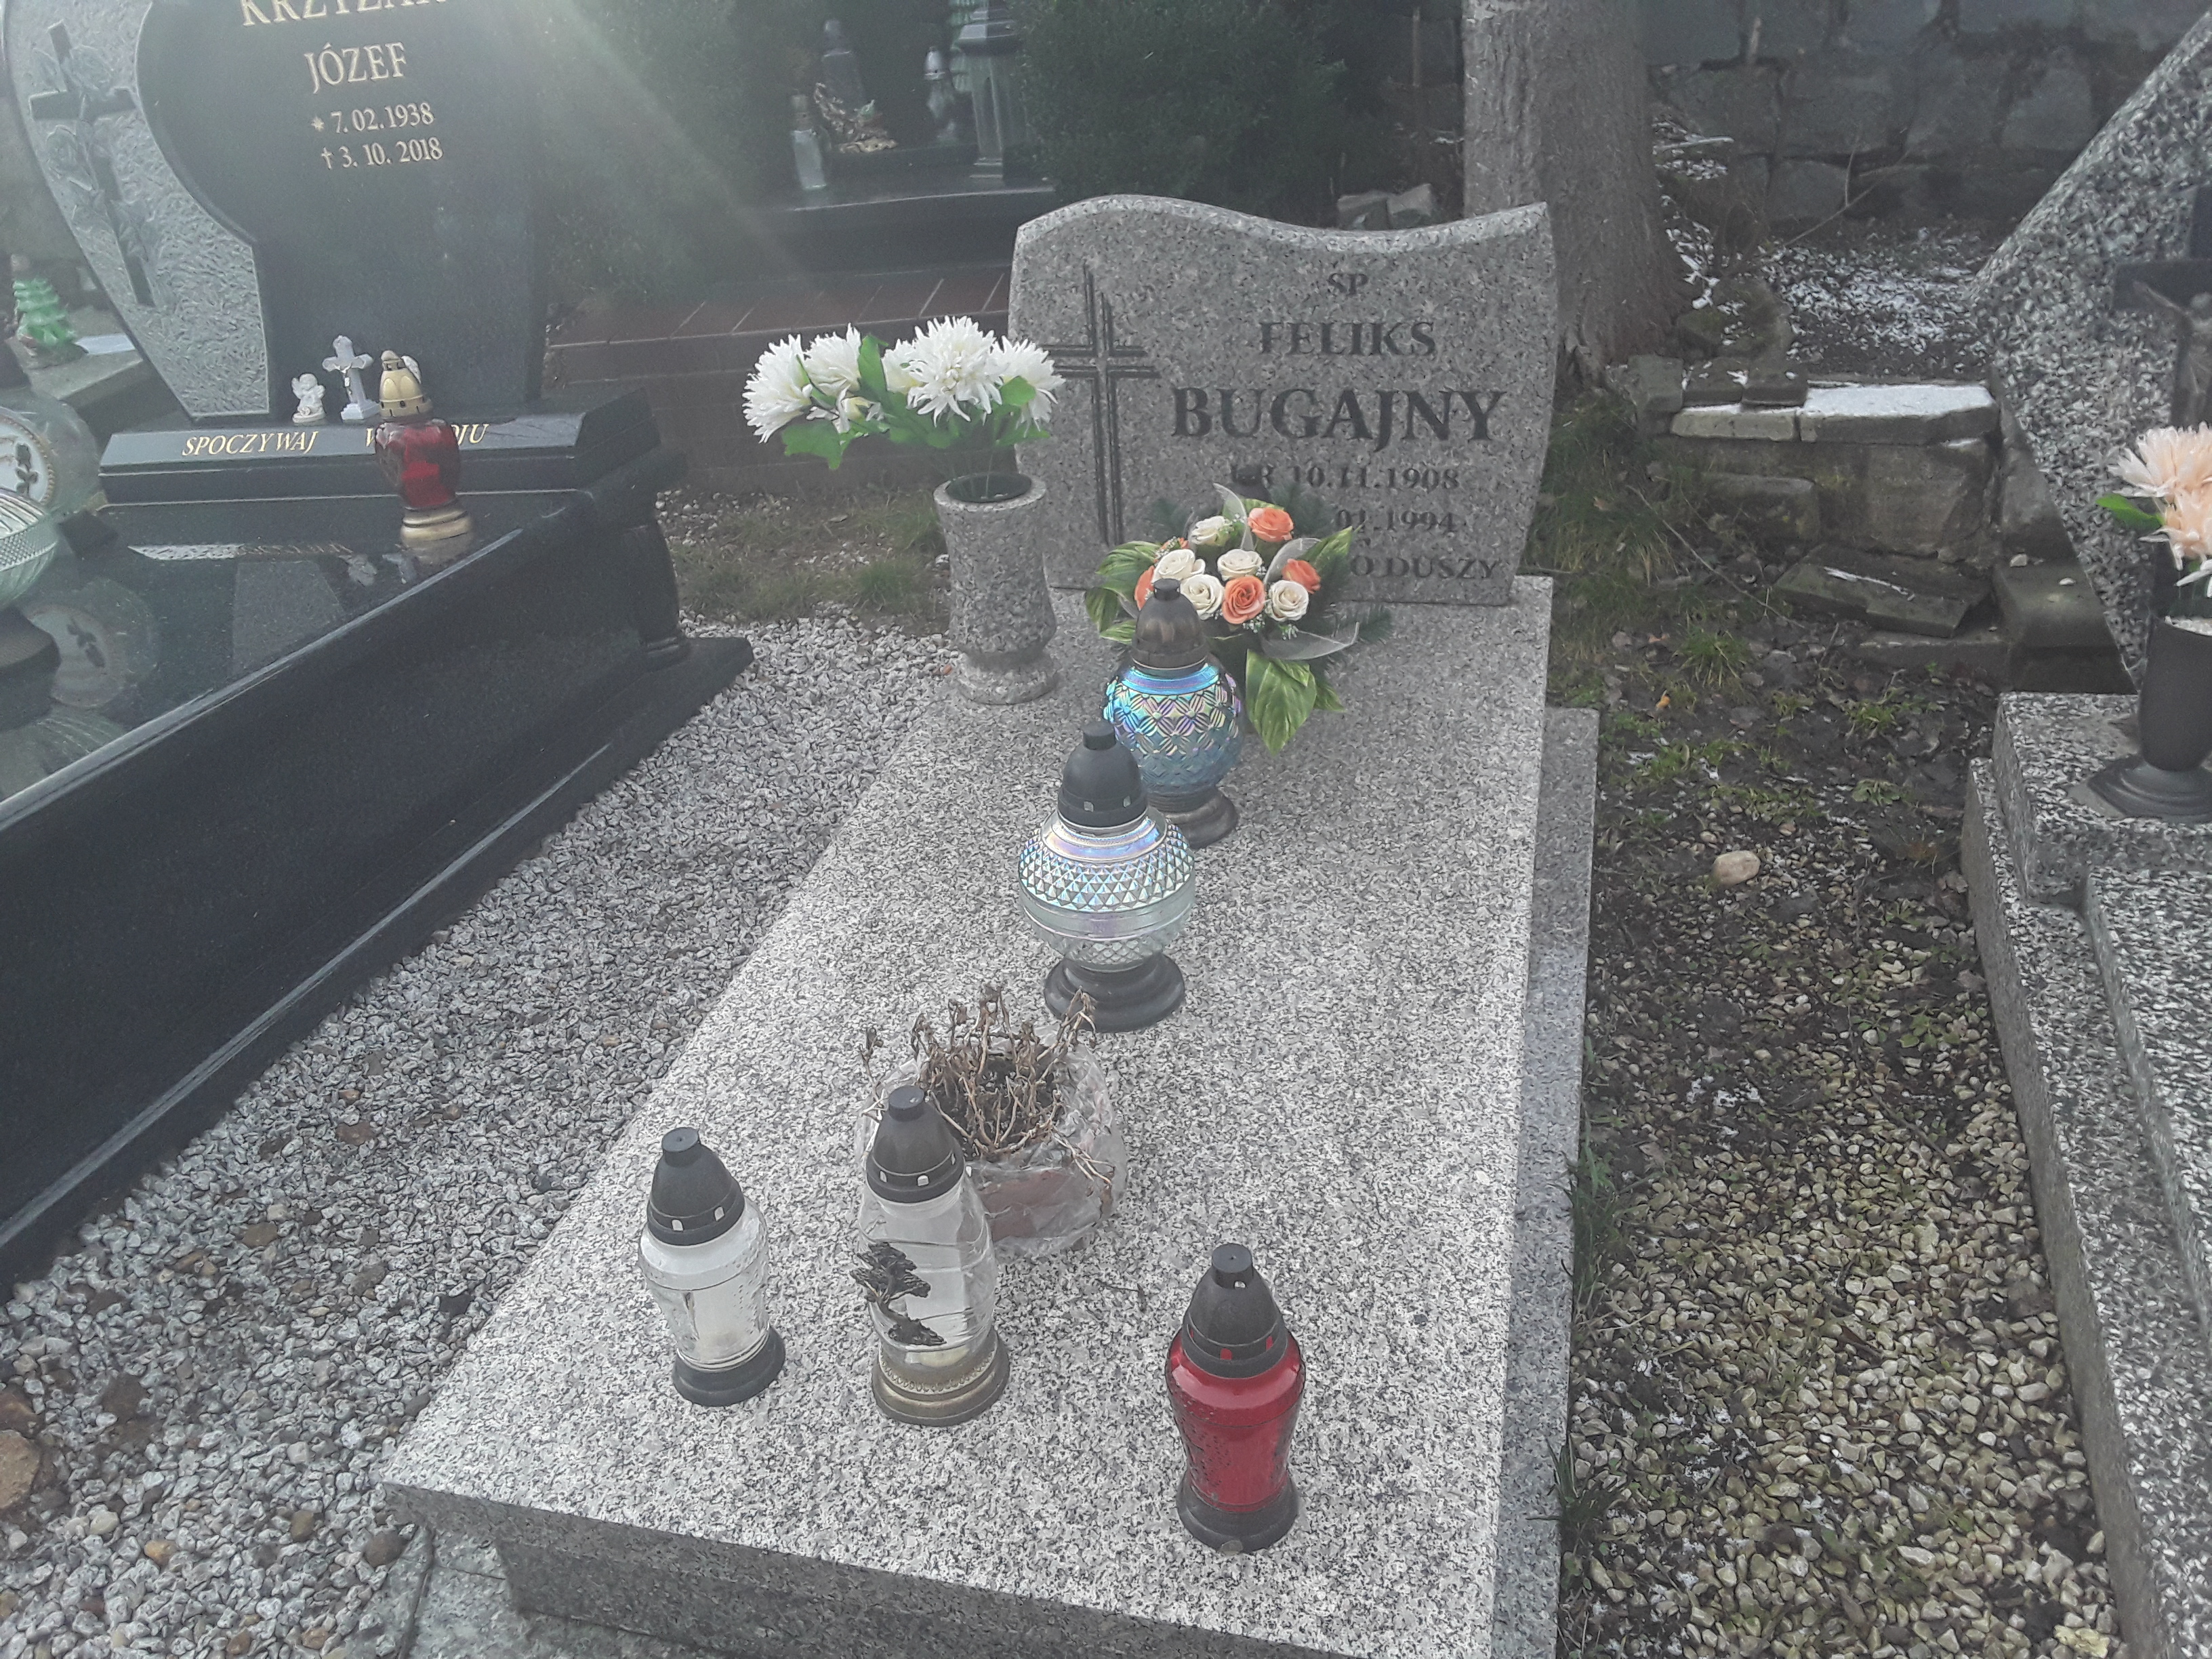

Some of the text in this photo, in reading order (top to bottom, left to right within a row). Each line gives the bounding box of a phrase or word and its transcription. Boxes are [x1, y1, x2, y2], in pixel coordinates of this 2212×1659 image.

[304, 42, 406, 94] JÓZEF
[1259, 322, 1436, 356] FELIKS
[1171, 387, 1507, 453] BUGAJNY
[182, 430, 319, 457] SPOCZYWAJ
